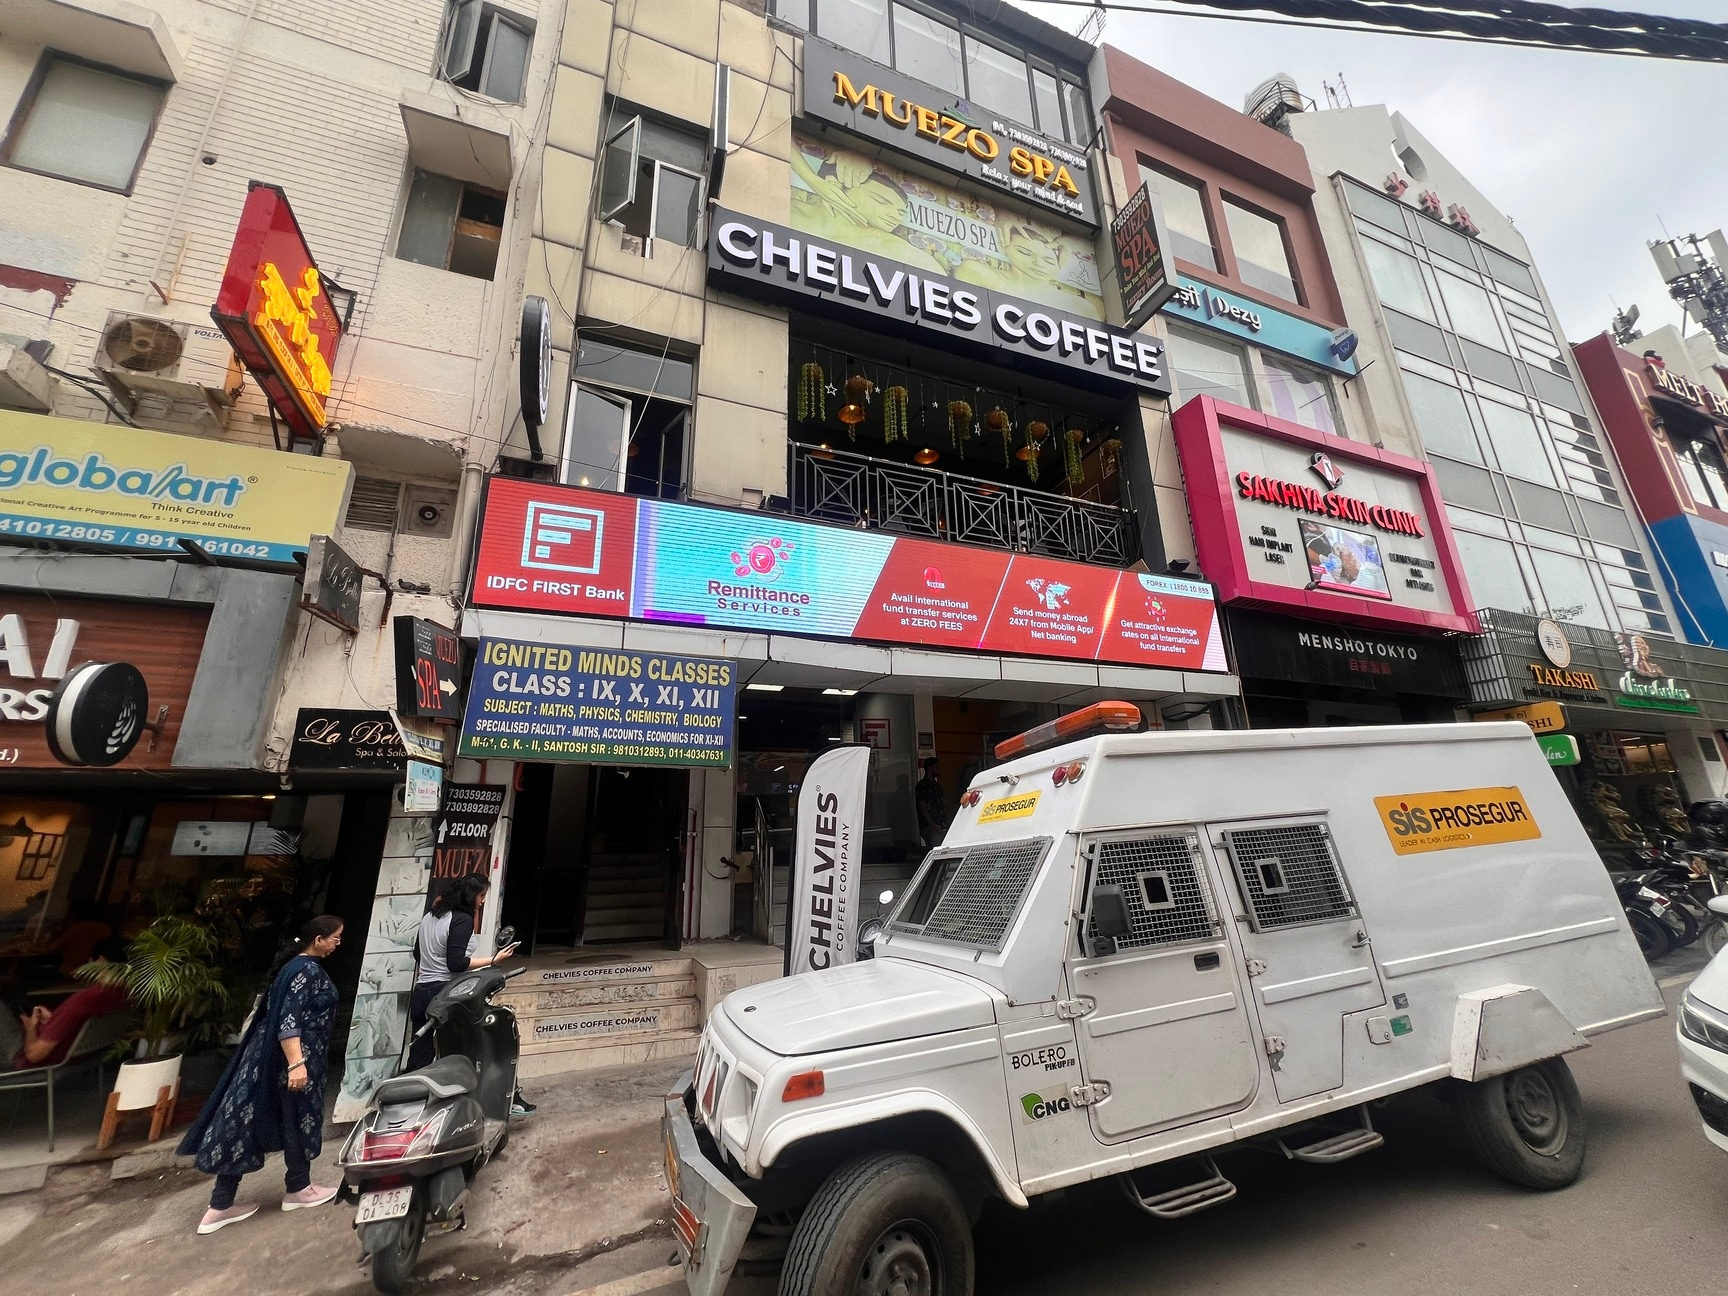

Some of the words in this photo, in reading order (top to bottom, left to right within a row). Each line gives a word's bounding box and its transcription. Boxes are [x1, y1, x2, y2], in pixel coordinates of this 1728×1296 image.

[832, 70, 999, 161] MUEZO
[1010, 146, 1080, 198] SPA
[981, 163, 1009, 183] Relax
[1012, 178, 1032, 191] your
[1035, 187, 1056, 201] mind
[908, 205, 967, 240] MUEZO
[970, 223, 999, 254] SPA
[1115, 201, 1150, 252] MUEZO
[1121, 226, 1157, 281] SPA
[717, 221, 982, 329] CHELVIES
[994, 303, 1162, 380] COFFEE
[1215, 295, 1262, 331] Dezy
[151, 502, 182, 514] Think
[186, 507, 234, 519] Creative
[1236, 471, 1328, 513] SAKHIYA
[1324, 492, 1371, 525] SKIN
[1371, 504, 1426, 538] CLINIC
[27, 500, 65, 510] Creative
[85, 507, 137, 519] Programme
[139, 513, 153, 521] for
[202, 520, 215, 528] old
[217, 522, 251, 532] Children
[1261, 525, 1278, 538] SKIN
[1249, 535, 1266, 548] HAIR
[1266, 539, 1293, 554] IMPLANT
[1264, 551, 1285, 565] LASER
[487, 575, 529, 592] IDFC
[532, 580, 581, 597] FIRST
[585, 586, 625, 602] Bank
[707, 579, 811, 606] Remittance
[1146, 579, 1167, 589] FOREX
[717, 598, 801, 618] Services
[882, 603, 904, 613] fund
[905, 606, 940, 618] transfer
[942, 611, 978, 622] services
[891, 593, 913, 603] Avail
[915, 596, 969, 610] international
[900, 618, 910, 626] at
[911, 618, 937, 629] ZERO
[939, 621, 963, 631] FEES
[1009, 617, 1029, 627] 24X7
[1030, 620, 1049, 629] from
[1050, 621, 1075, 632] Mobile
[1012, 606, 1034, 617] Send
[1035, 611, 1061, 622] money
[1062, 614, 1089, 623] abroad
[1031, 630, 1045, 639] Net
[1046, 633, 1077, 644] banking
[1120, 619, 1133, 629] Get
[1134, 622, 1166, 632] attractive
[1166, 625, 1198, 637] exchange
[1121, 630, 1139, 639] rates
[1150, 633, 1159, 641] all
[1140, 641, 1156, 651] fund
[1156, 643, 1187, 654] transfers
[1298, 631, 1418, 661] MENSHOTOKYO
[483, 641, 573, 672] IGNITED
[577, 651, 642, 679] MINDS
[647, 659, 730, 687] CLASSES
[417, 657, 442, 709] SPA
[1530, 664, 1600, 692] TAKASHI
[492, 671, 571, 698] CLASS
[592, 679, 621, 704] IX,
[627, 682, 649, 708] X,
[656, 685, 685, 710] XI,
[691, 688, 719, 709] XII
[484, 698, 532, 716] SUBJECT
[539, 703, 576, 720] MATHS,
[579, 707, 623, 724] PHYSICS,
[625, 710, 679, 728] CHEMISTRY,
[684, 714, 723, 729] BIOLOGY
[299, 718, 342, 746] La
[476, 719, 530, 735] SPECIALISED
[531, 722, 566, 737] FACULTY
[572, 726, 601, 740] MATHS,
[602, 728, 646, 743] ACCOUNTS,
[646, 730, 689, 744] ECONOMICS
[690, 733, 704, 745] FOR
[705, 734, 724, 746] XI-XII
[355, 747, 374, 759] Spa
[376, 748, 384, 757] &
[500, 739, 510, 749] G.
[512, 739, 523, 750] K.
[543, 739, 588, 755] SANTOSH
[590, 742, 607, 755] SIR
[613, 744, 667, 760] 9810312893,
[668, 747, 724, 761] 011-40347631
[448, 787, 502, 802] 7303592828
[445, 801, 500, 815] 7303892828
[995, 797, 1036, 815] PROSEGUR
[1429, 801, 1528, 830] PROSEGUR
[450, 822, 488, 838] 2FLOOR
[1400, 839, 1418, 848] LEADER
[1427, 837, 1442, 845] CASH
[1443, 833, 1467, 843] LOGISTICS
[839, 823, 850, 892] COMPANY
[809, 791, 838, 972] CHELVIES
[837, 897, 847, 952] COFFEE
[542, 970, 581, 980] CHELVIES
[583, 968, 613, 977] COFFEE
[614, 965, 653, 975] COMPANY
[535, 1022, 578, 1033] CHELVIES
[580, 1019, 613, 1029] COFFEE
[615, 1015, 658, 1026] COMPANY
[1012, 1046, 1066, 1070] BOLERO
[1045, 1060, 1067, 1072] PIK-UP
[1033, 1097, 1070, 1119] CNG
